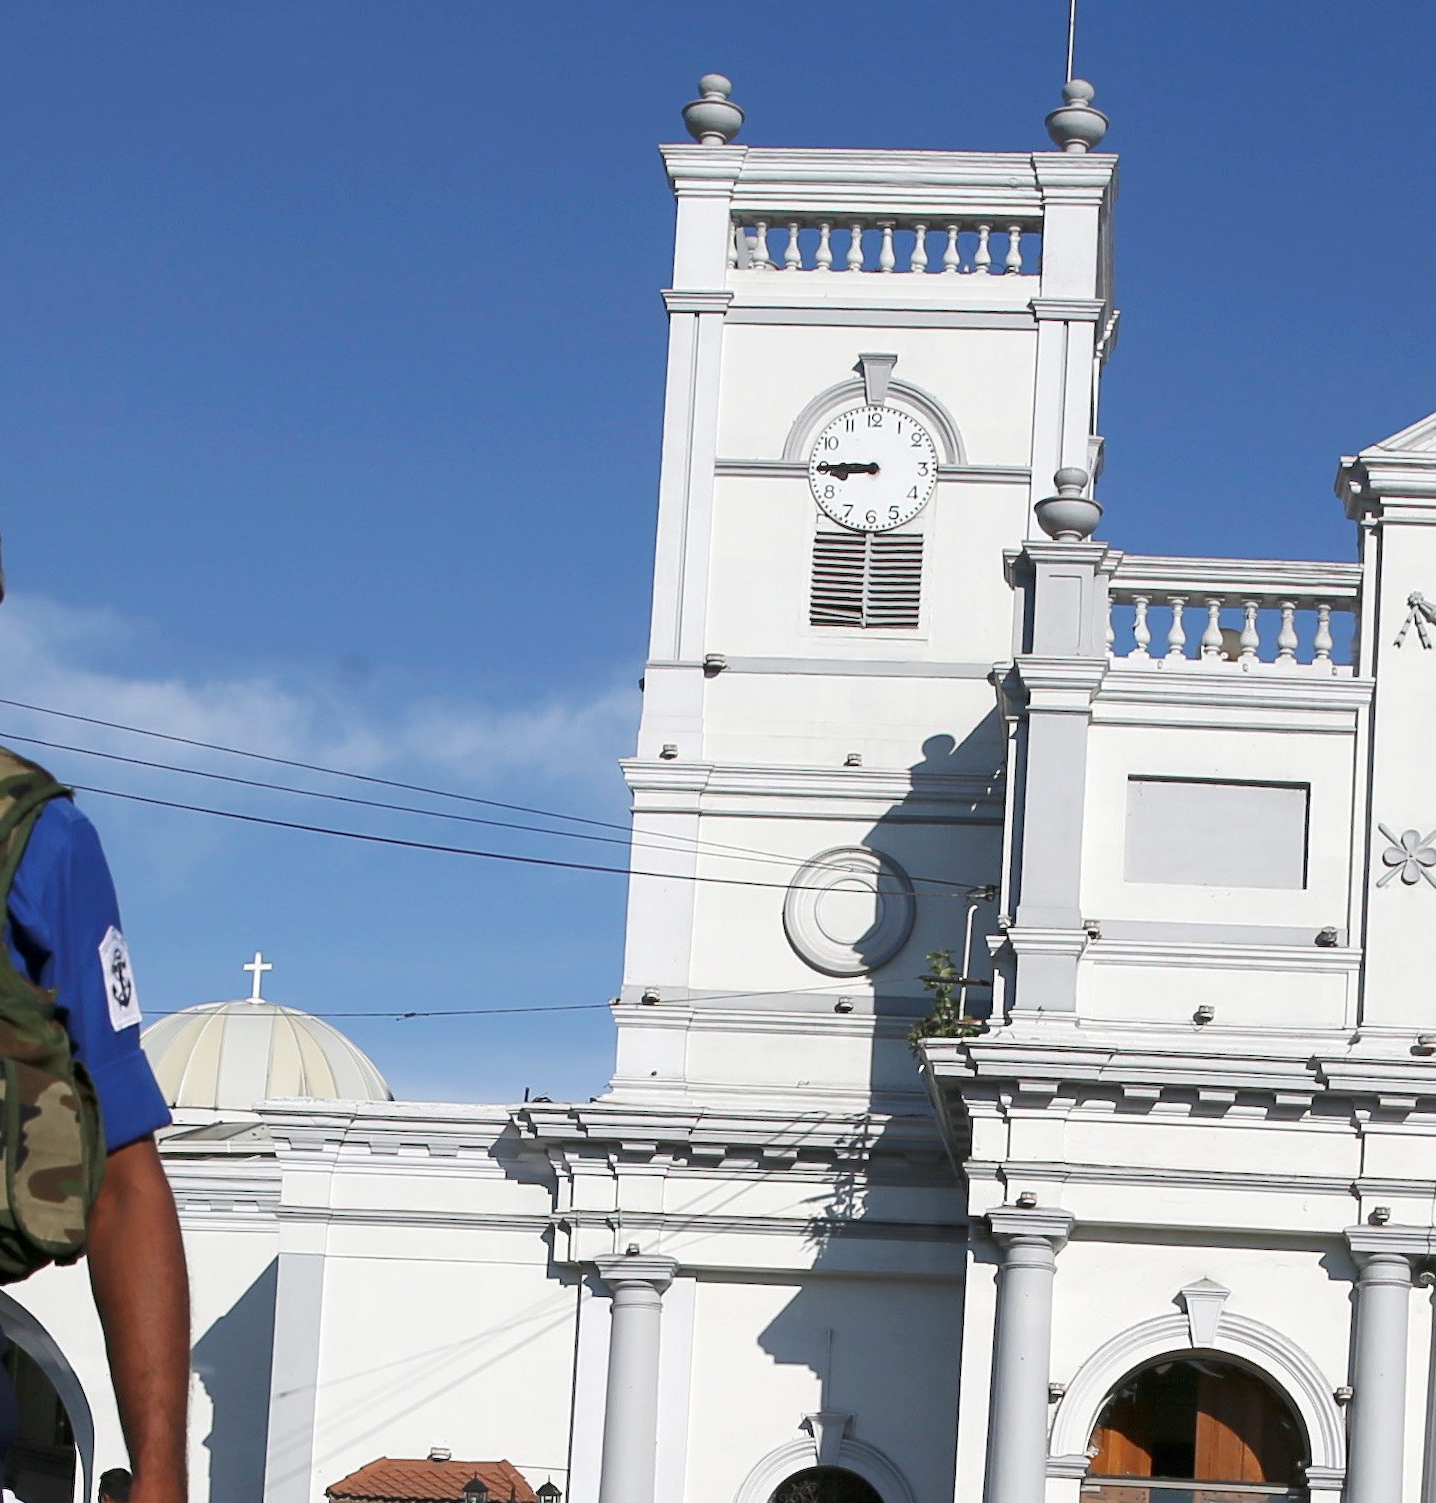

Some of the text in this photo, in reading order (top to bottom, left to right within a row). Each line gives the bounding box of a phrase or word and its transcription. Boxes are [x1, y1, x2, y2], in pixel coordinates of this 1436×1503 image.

[846, 419, 854, 432] 11
[867, 413, 882, 428] 12
[897, 421, 901, 434] 1
[824, 436, 839, 450] 10
[910, 432, 922, 447] 2
[917, 462, 928, 477] 3
[824, 484, 835, 499] 8
[906, 485, 919, 499] 4
[843, 504, 854, 517] 7
[865, 509, 877, 524] 6
[888, 505, 900, 520] 5
